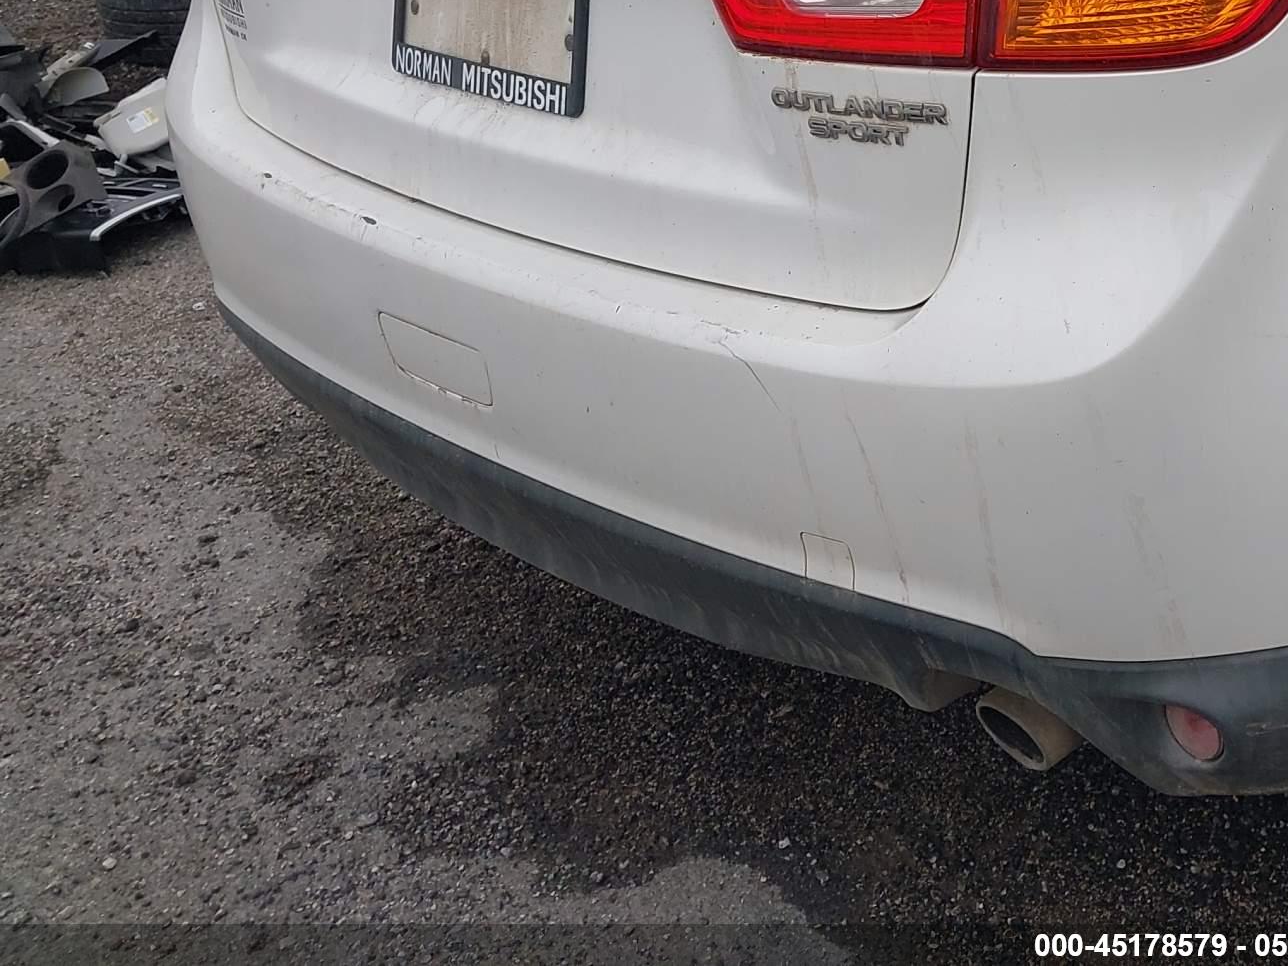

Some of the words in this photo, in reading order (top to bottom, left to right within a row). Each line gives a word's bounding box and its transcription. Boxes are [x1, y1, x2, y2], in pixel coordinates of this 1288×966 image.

[395, 43, 453, 86] NORMAN
[461, 62, 567, 116] MITSUBISHI
[770, 86, 949, 126] OUTLANDER
[807, 116, 910, 147] SPORT
